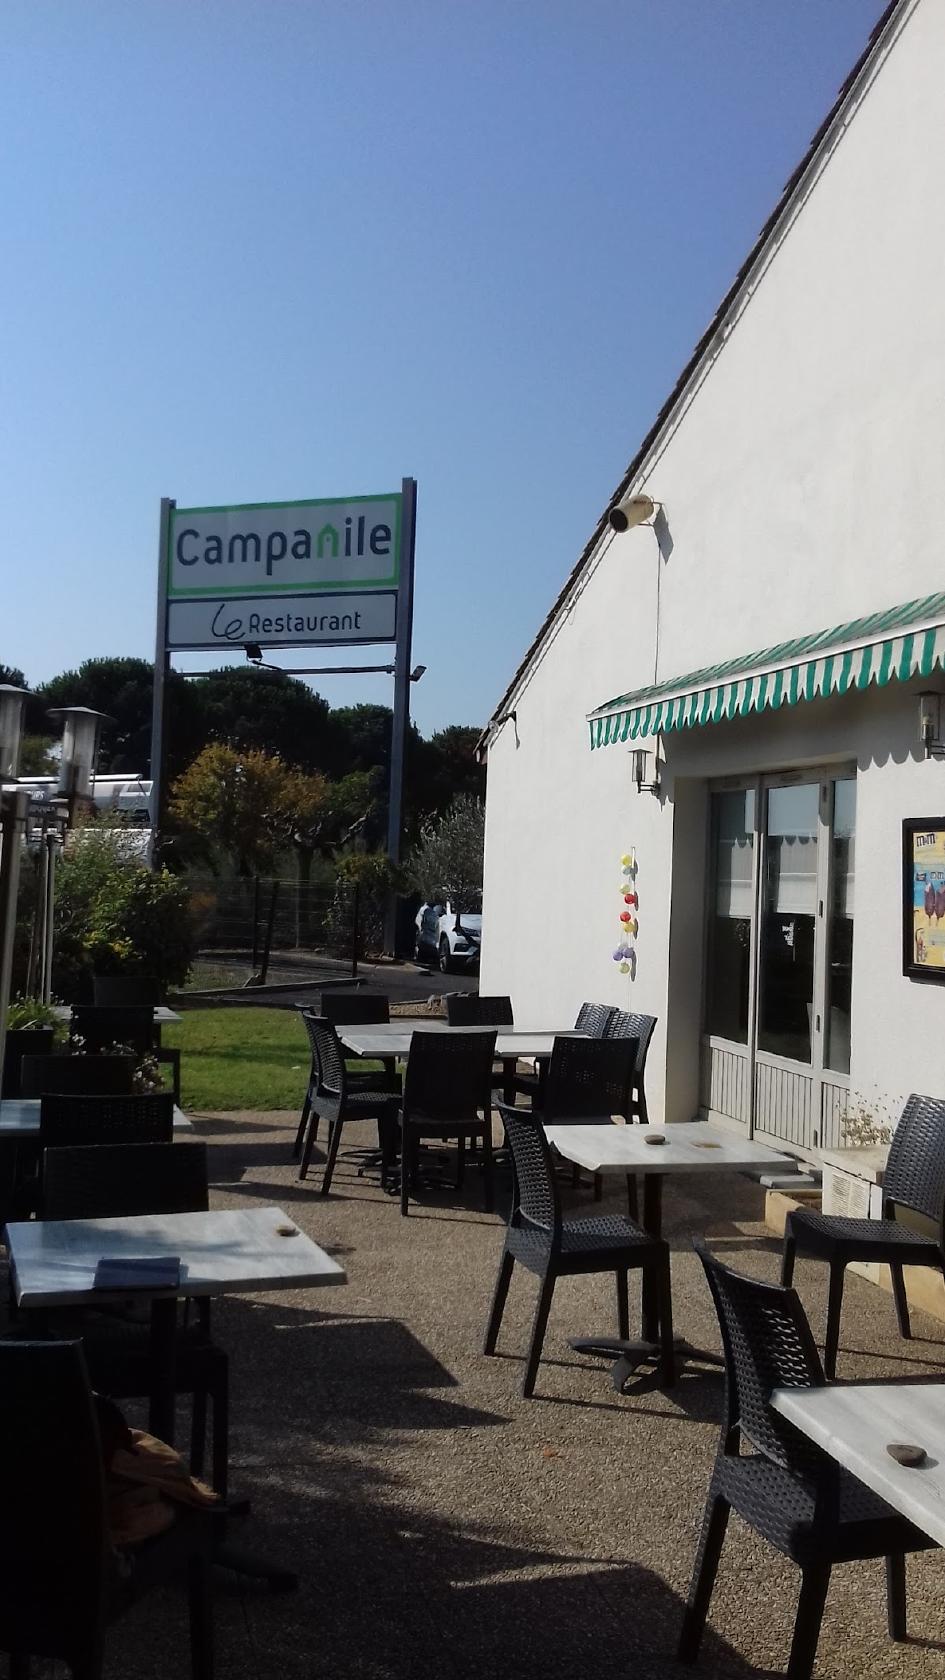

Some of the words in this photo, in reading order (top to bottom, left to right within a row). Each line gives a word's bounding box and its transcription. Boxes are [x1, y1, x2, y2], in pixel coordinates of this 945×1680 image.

[176, 516, 392, 576] Campanile
[211, 603, 246, 640] Le
[249, 611, 361, 634] Restaurant
